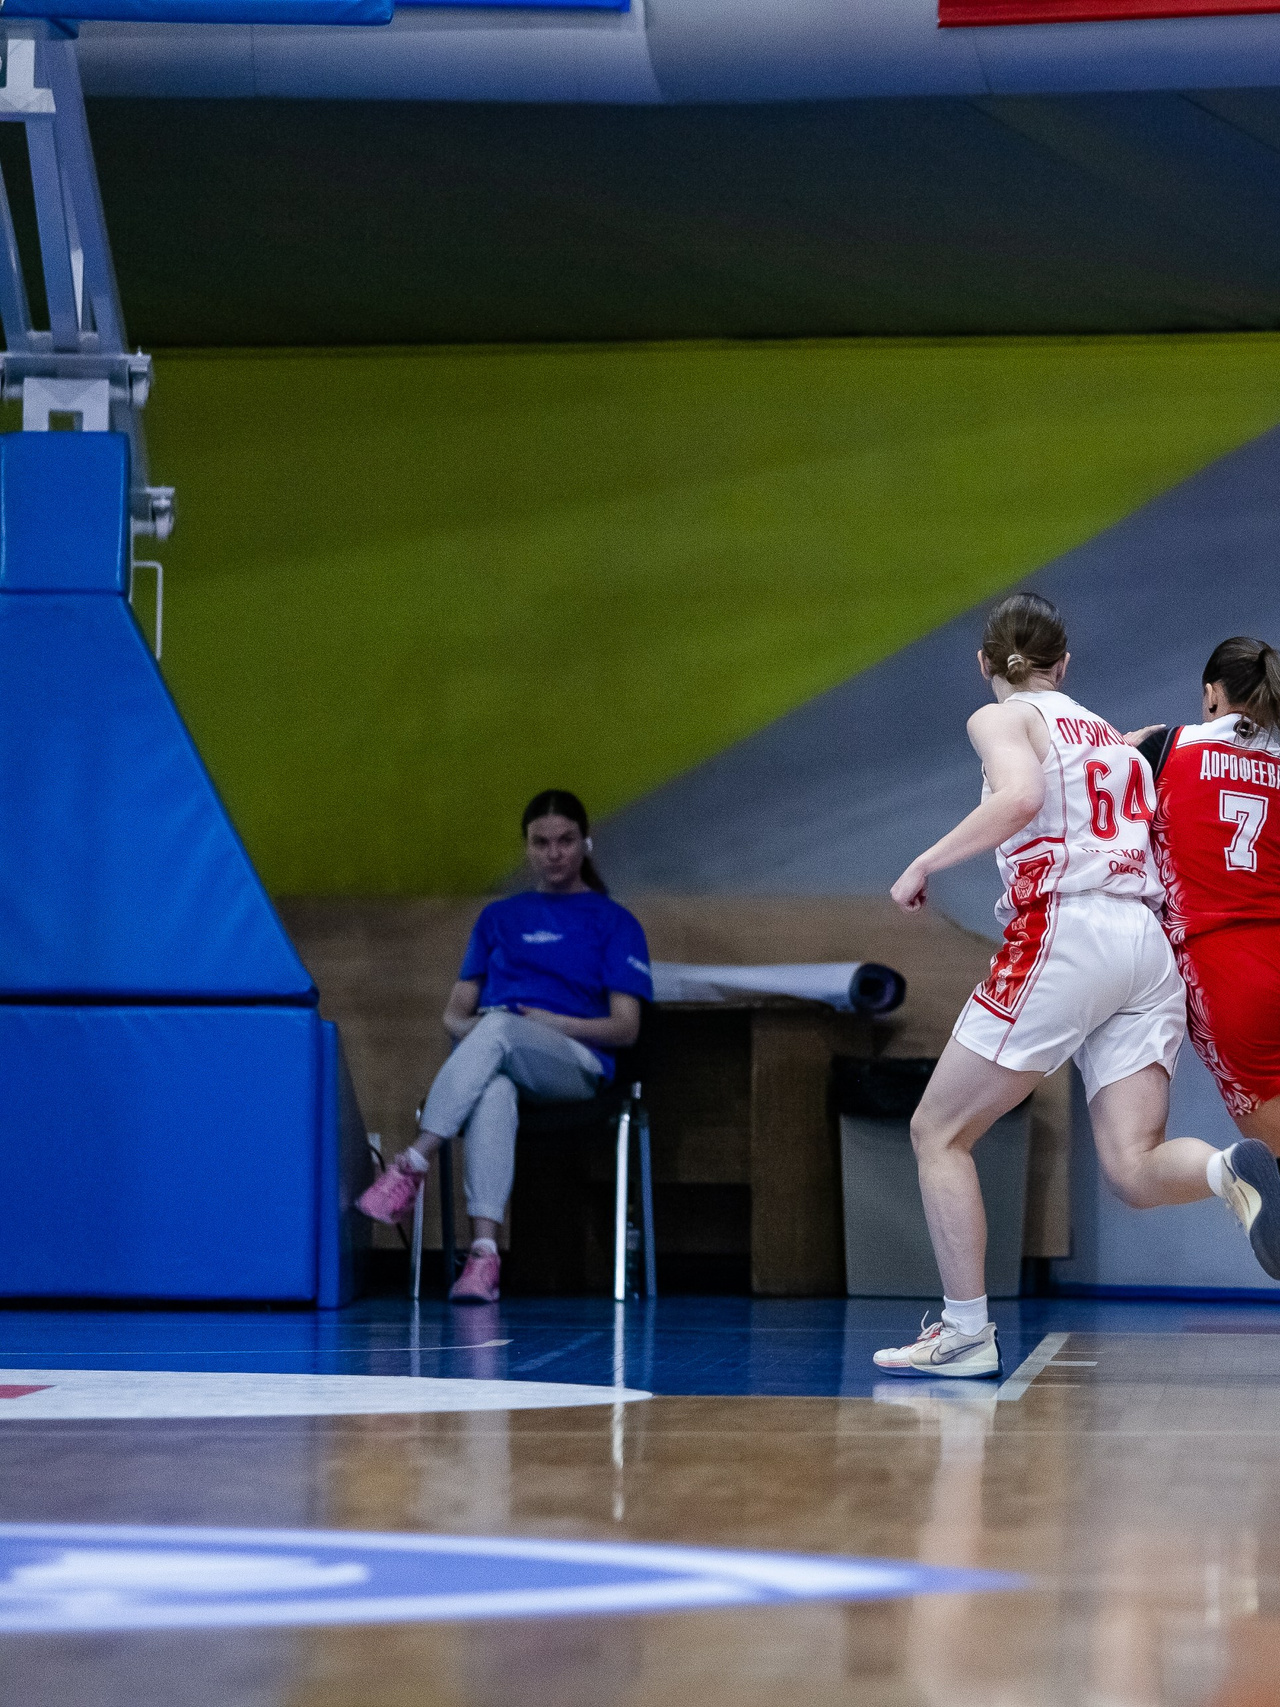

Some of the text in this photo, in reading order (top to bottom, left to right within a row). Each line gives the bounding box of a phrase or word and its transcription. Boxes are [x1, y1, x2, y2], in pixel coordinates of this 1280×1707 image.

[1055, 717, 1133, 748] ПУЗИКО
[1083, 757, 1155, 841] 64
[1219, 789, 1269, 873] 7
